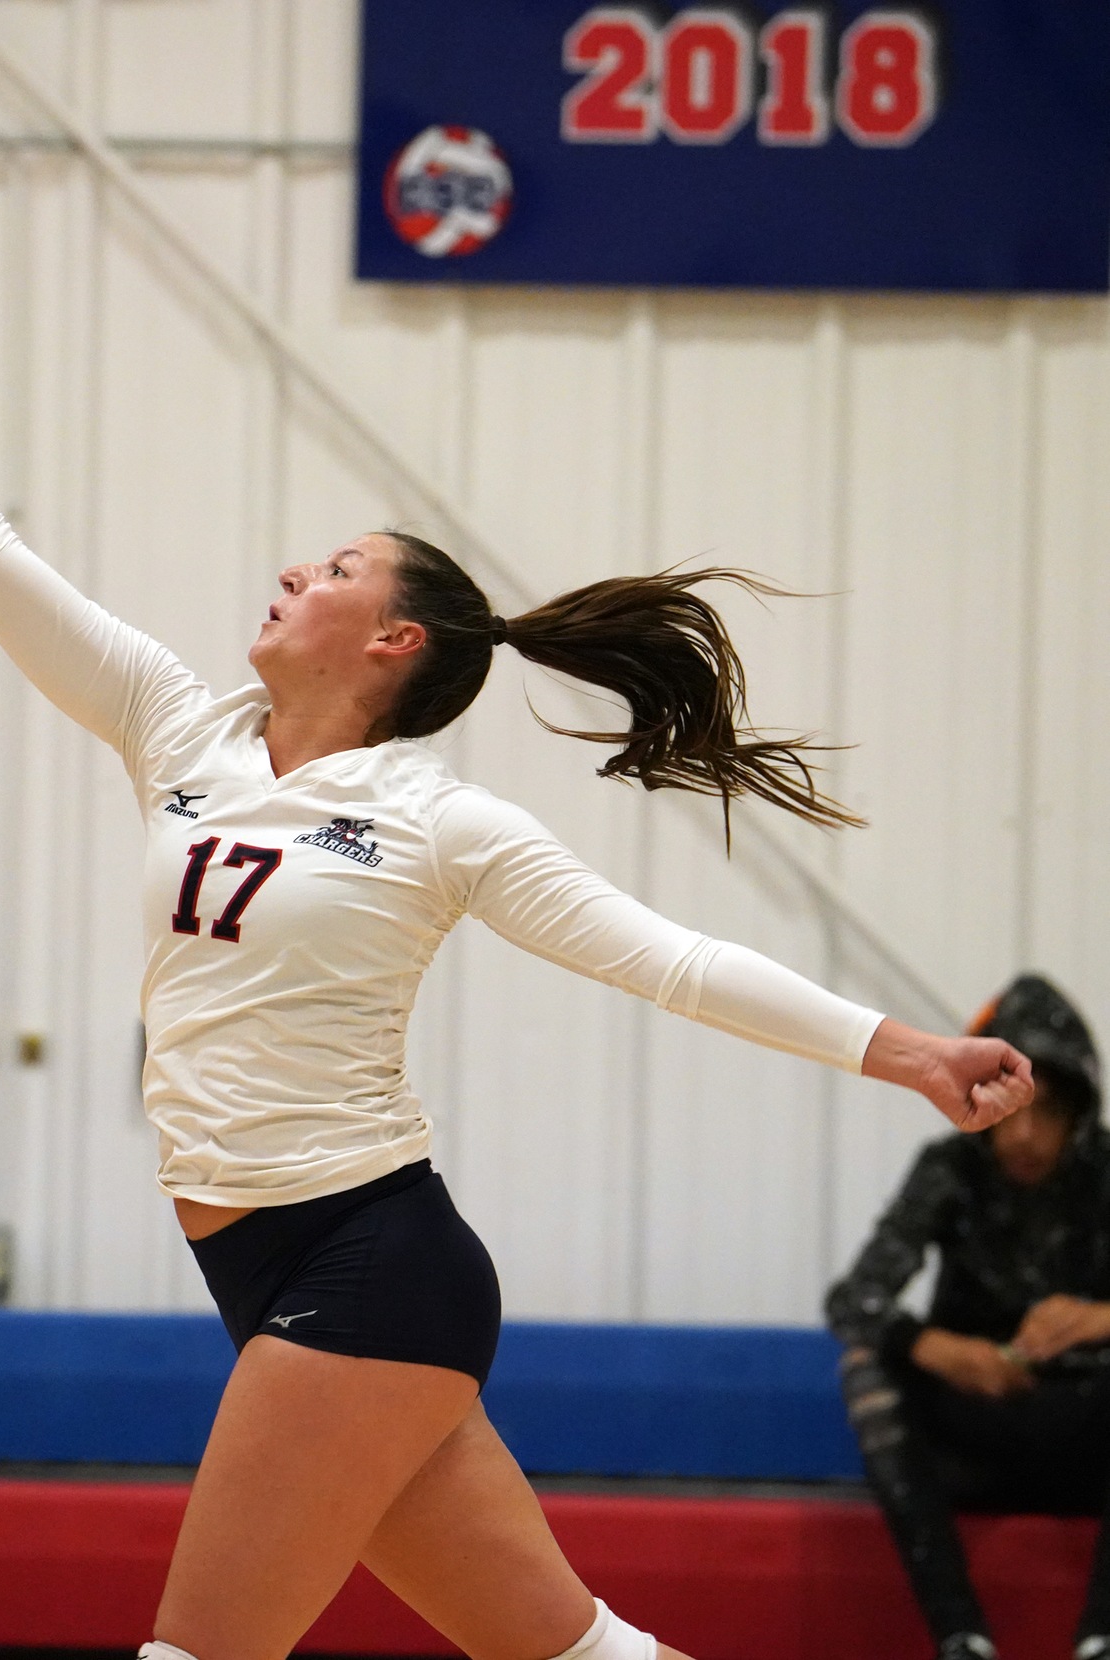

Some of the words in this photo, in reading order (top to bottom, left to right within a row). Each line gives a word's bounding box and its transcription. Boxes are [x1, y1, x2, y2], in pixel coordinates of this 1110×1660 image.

[562, 8, 934, 146] 2018
[164, 803, 199, 819] MIZUNO
[293, 834, 384, 868] CHARGERS
[172, 836, 283, 943] 17
